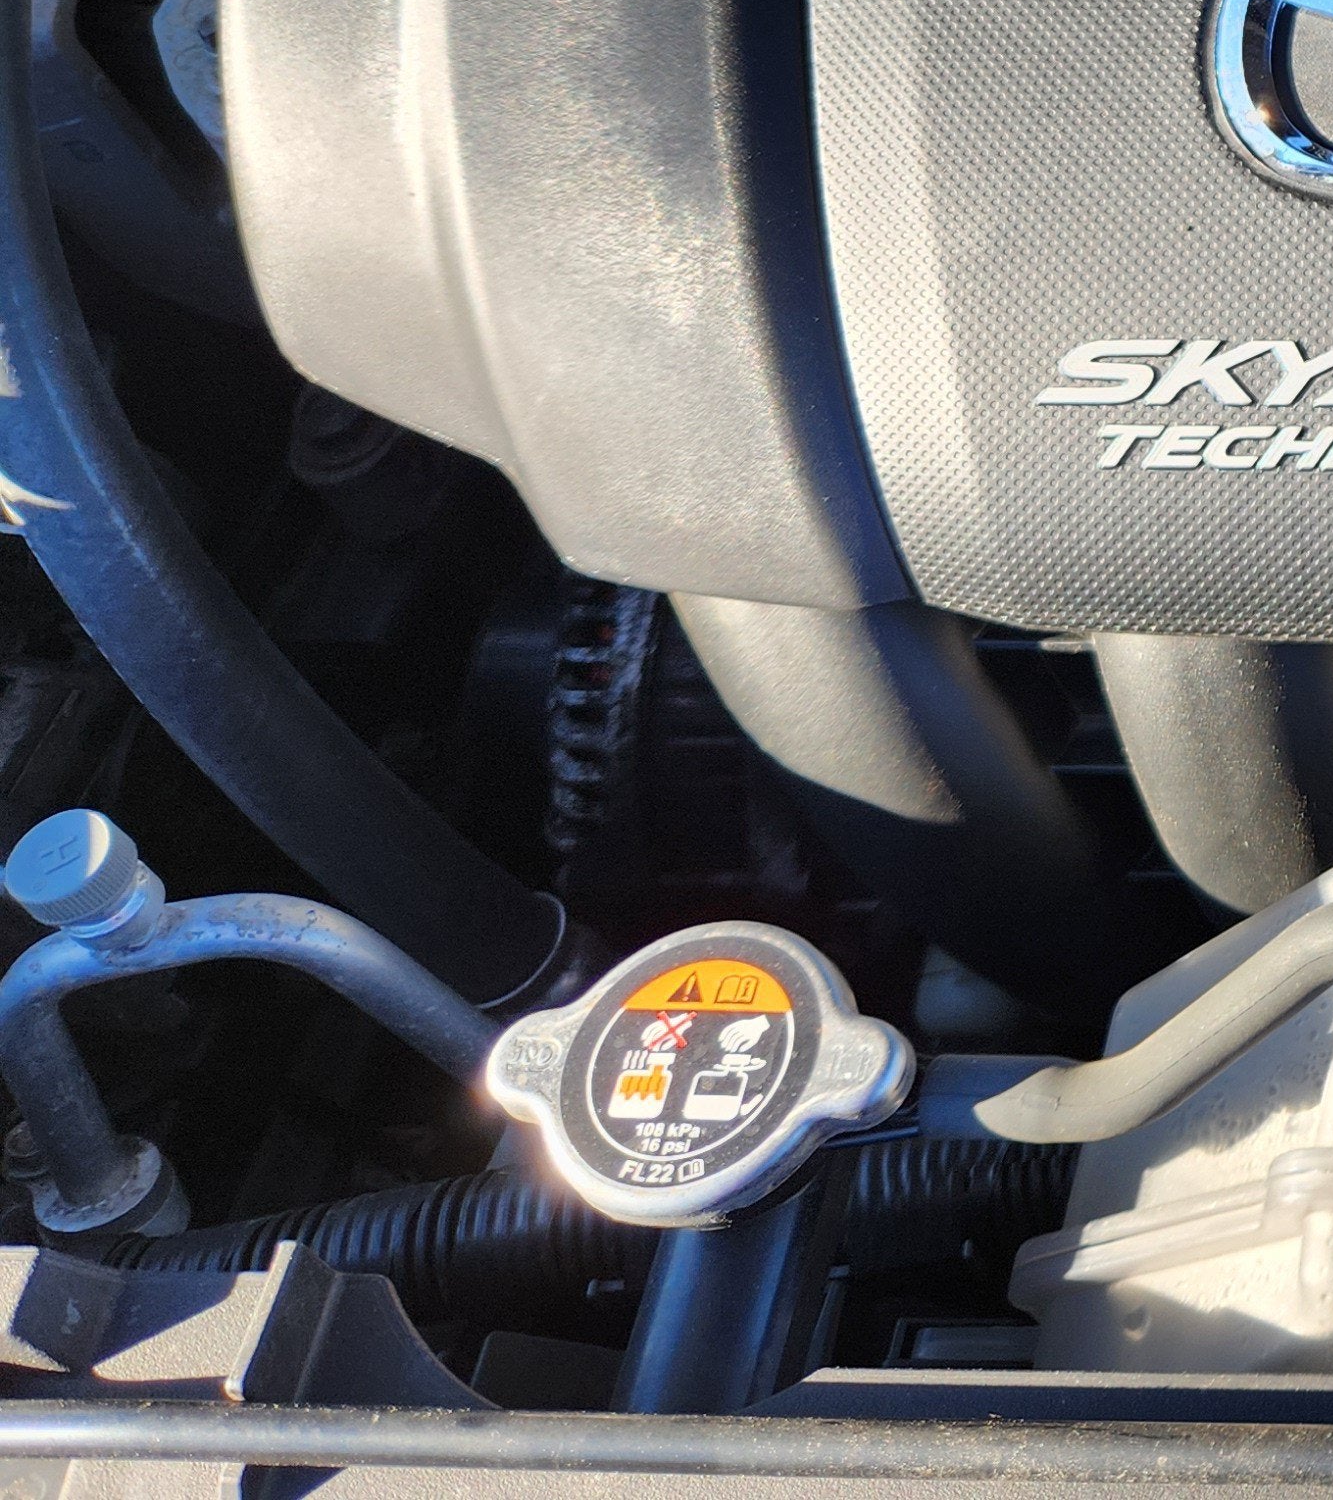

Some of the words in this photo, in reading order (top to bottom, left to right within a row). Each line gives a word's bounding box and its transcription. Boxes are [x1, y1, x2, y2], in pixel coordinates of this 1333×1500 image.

[634, 1122, 665, 1137] 108
[667, 1122, 700, 1139] kPa
[640, 1138, 661, 1153] 16
[661, 1138, 691, 1156] psi
[618, 1159, 675, 1184] FL22
